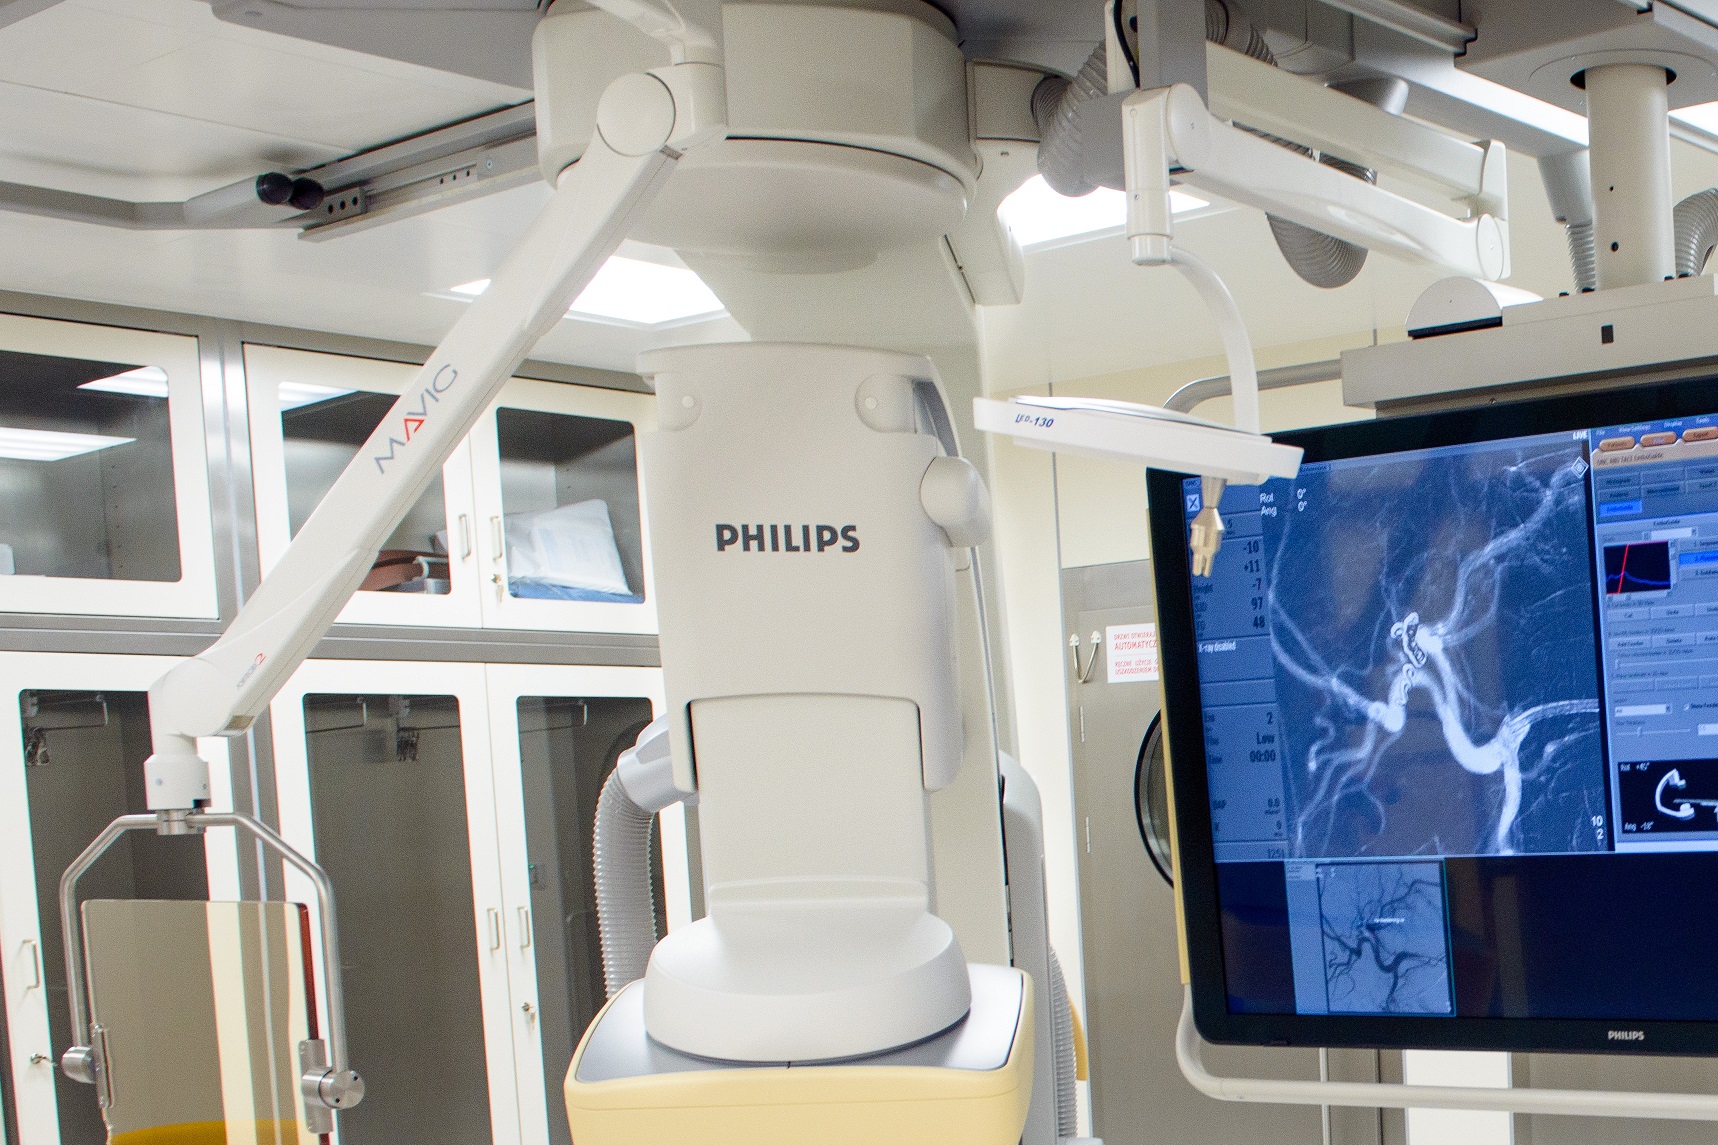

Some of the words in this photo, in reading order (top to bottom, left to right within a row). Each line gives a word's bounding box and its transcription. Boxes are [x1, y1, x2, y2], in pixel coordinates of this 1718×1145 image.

[374, 363, 458, 474] MAVIG
[1260, 506, 1277, 517] Ang
[715, 524, 860, 552] PHILIPS
[1251, 596, 1263, 610] 97
[1266, 711, 1274, 725] 2
[1256, 731, 1275, 745] Low
[1250, 750, 1277, 763] 00:00
[1591, 815, 1604, 827] 10
[1597, 829, 1605, 840] 2
[1608, 1030, 1645, 1041] PHILIPS
